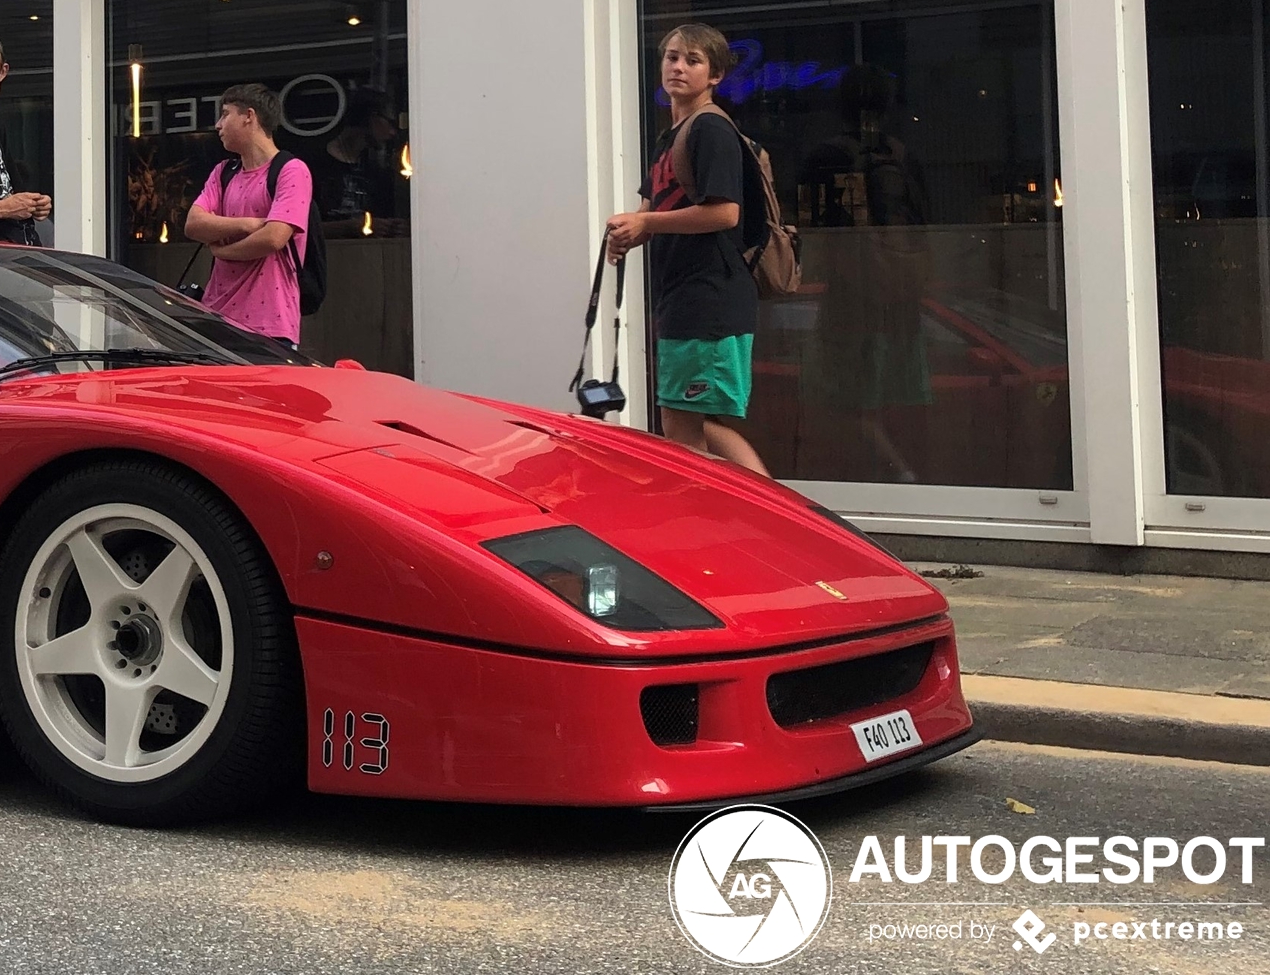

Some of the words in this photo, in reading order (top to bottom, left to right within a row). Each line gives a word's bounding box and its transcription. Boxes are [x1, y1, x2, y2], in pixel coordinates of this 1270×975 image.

[322, 707, 390, 775] 113
[862, 723, 890, 753] F40
[886, 716, 911, 745] 113
